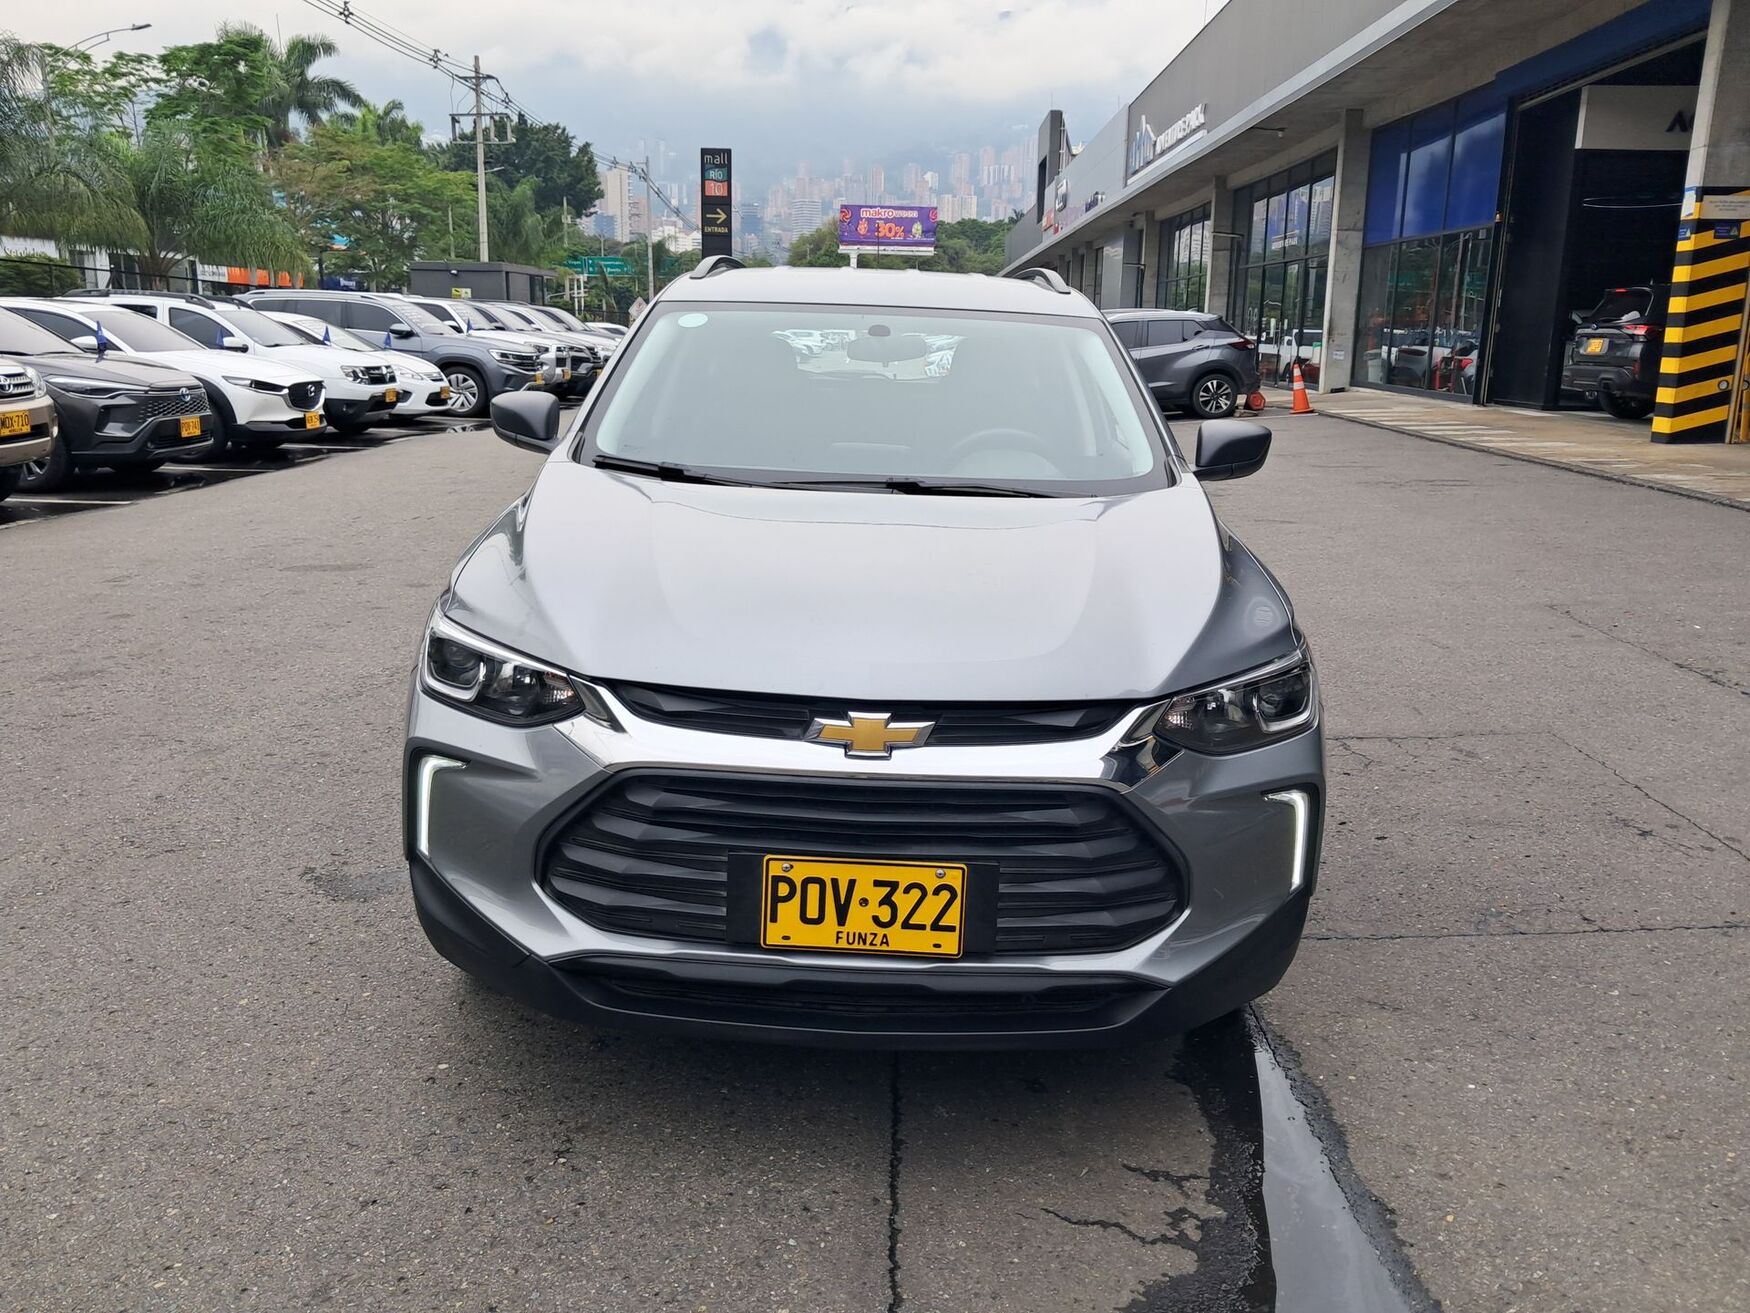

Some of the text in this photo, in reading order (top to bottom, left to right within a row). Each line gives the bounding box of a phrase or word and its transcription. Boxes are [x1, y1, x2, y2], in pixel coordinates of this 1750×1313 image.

[704, 152, 728, 164] mall
[861, 207, 895, 218] makro
[835, 931, 890, 947] FUNZA
